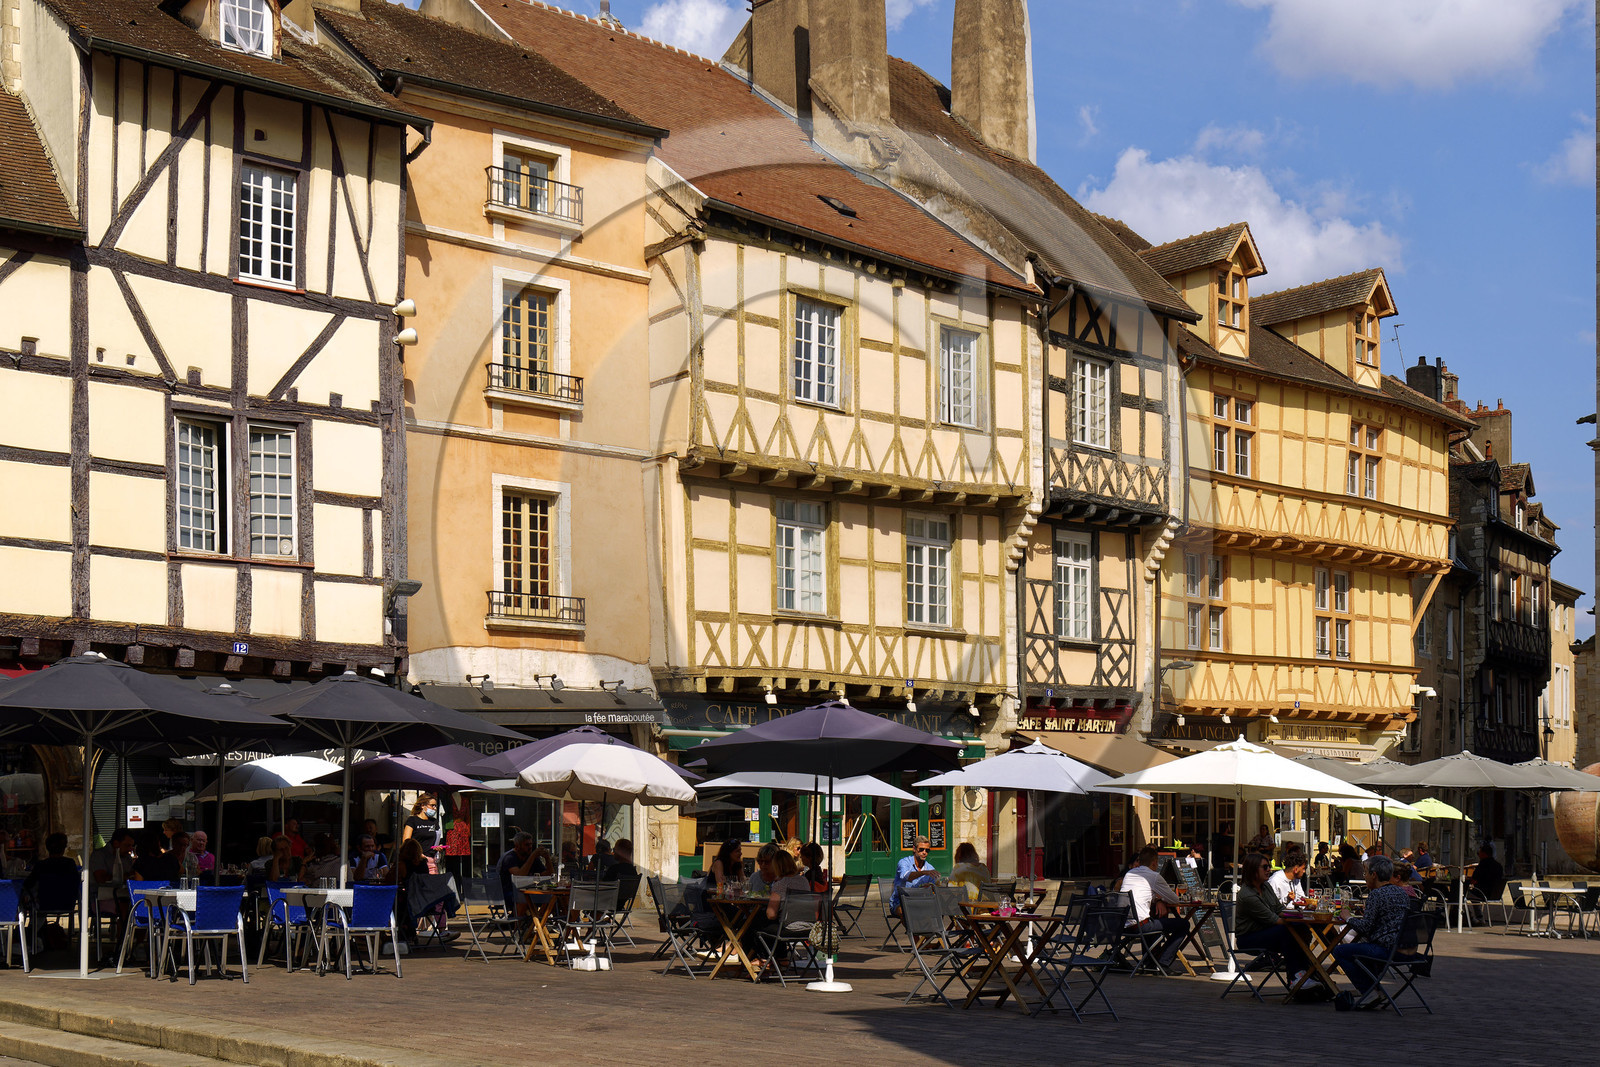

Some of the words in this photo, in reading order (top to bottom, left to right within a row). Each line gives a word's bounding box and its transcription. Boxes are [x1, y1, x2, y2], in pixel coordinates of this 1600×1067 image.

[236, 644, 247, 653] 12
[585, 714, 592, 722] la
[593, 712, 606, 724] fée
[608, 713, 655, 722] maraboutée
[1044, 718, 1075, 732] SAINT
[1077, 719, 1116, 734] MARTIN
[1162, 724, 1193, 738] SAINT
[1199, 725, 1243, 740] VINCENT
